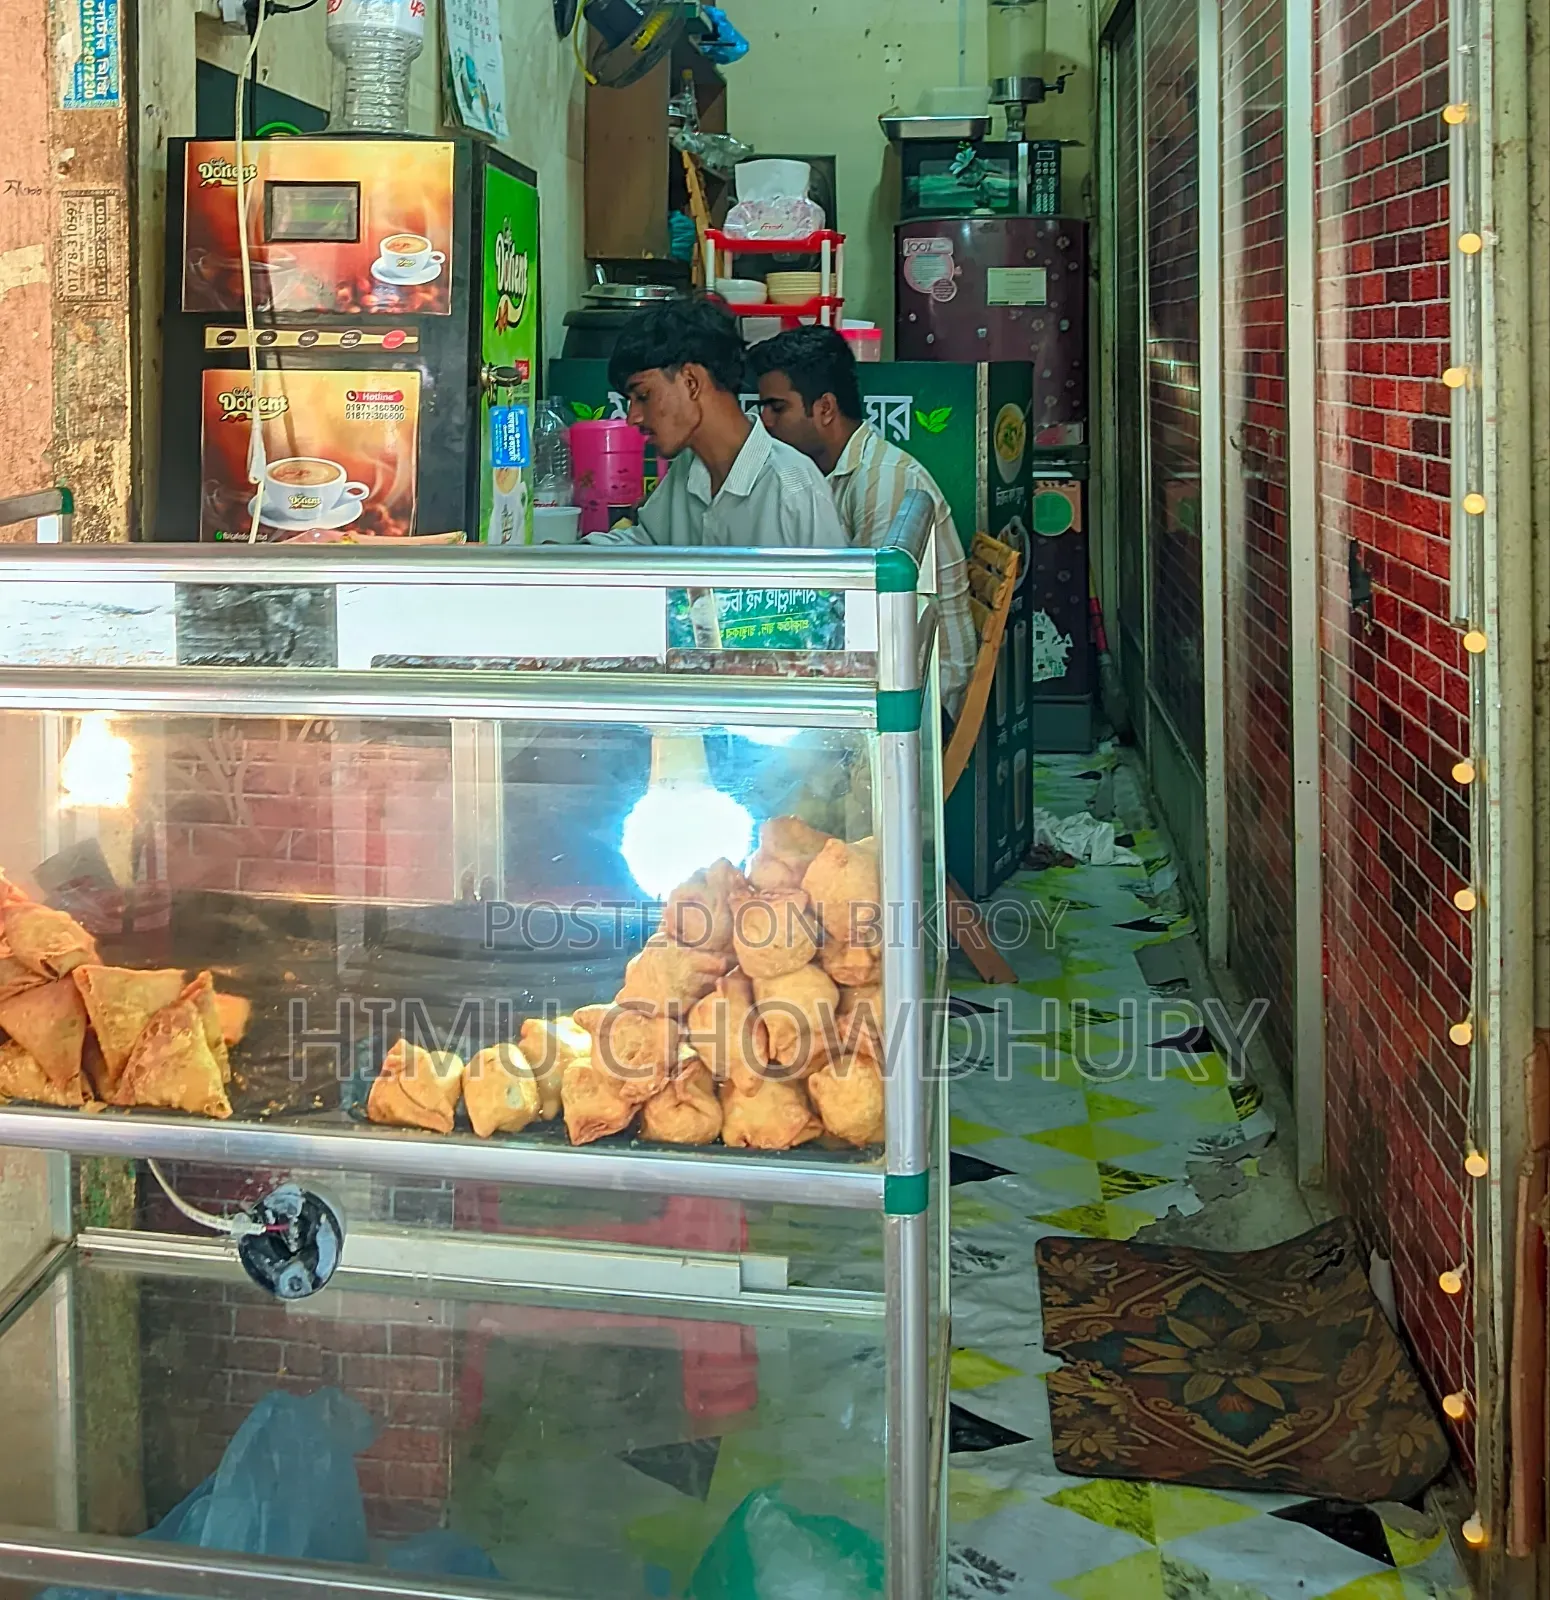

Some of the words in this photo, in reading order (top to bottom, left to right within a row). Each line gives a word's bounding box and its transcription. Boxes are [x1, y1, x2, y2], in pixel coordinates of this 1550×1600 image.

[82, 0, 95, 99] 01731-207230
[66, 200, 79, 292] 01778-310597
[217, 392, 289, 411] Dorent
[362, 392, 394, 401] Hotline
[863, 395, 913, 441] ঘর
